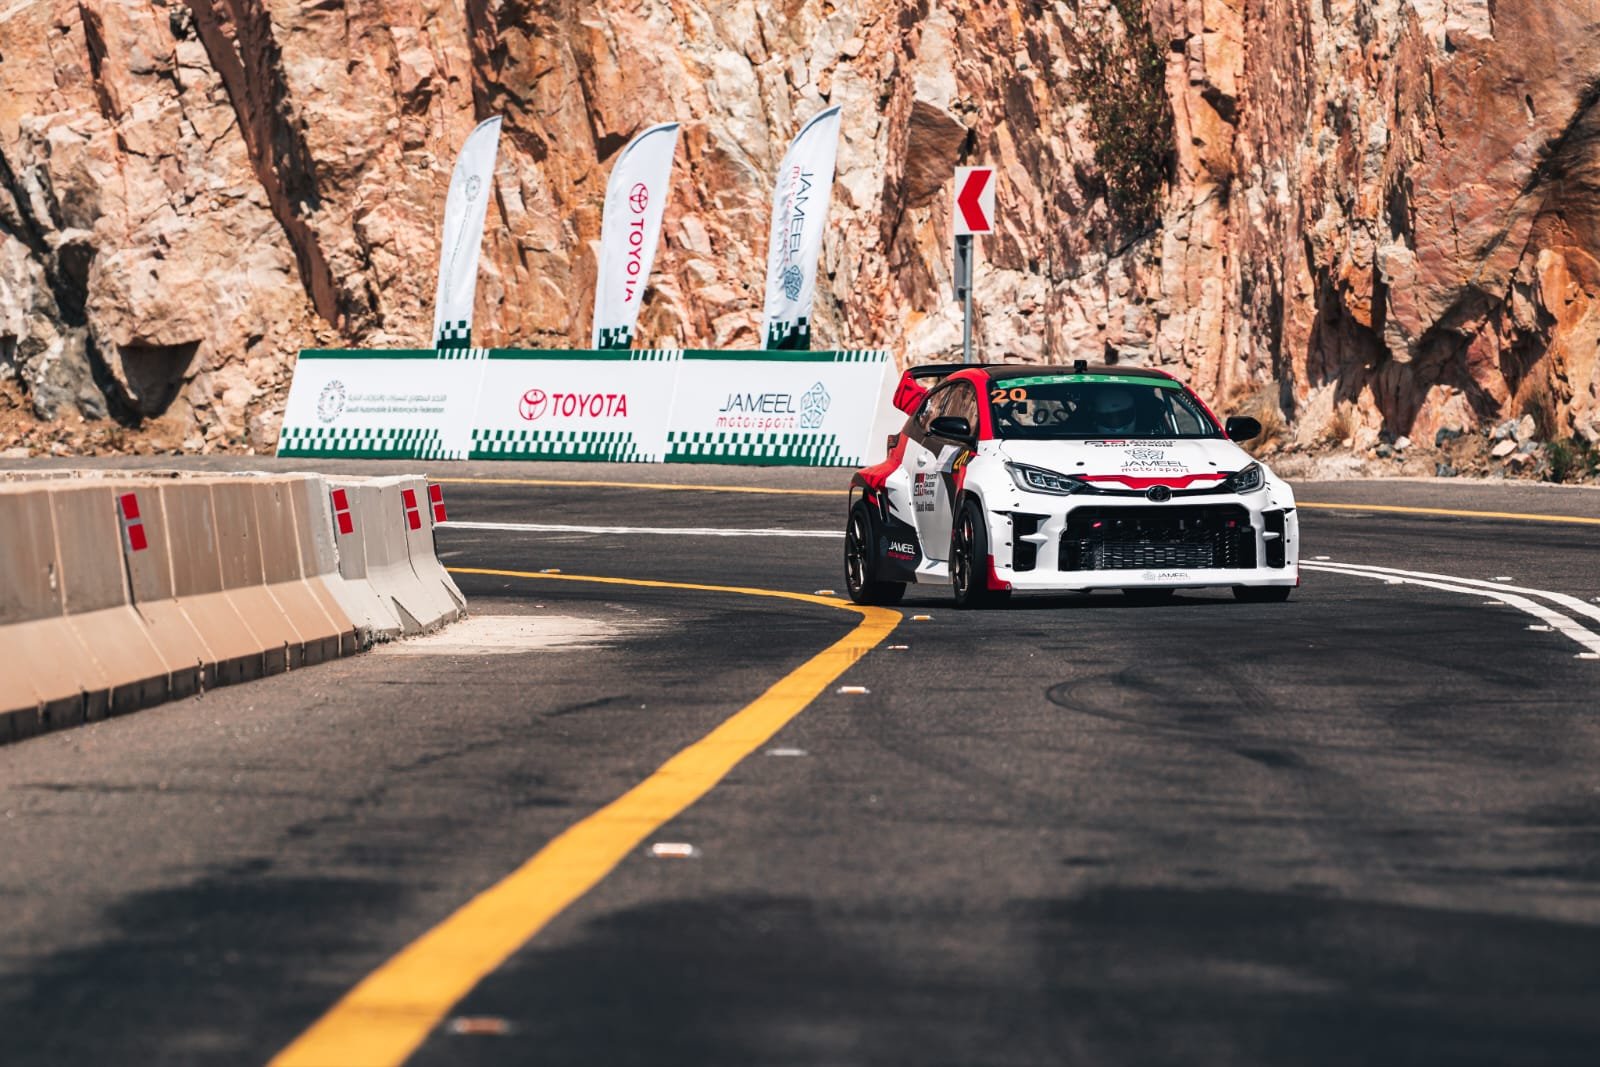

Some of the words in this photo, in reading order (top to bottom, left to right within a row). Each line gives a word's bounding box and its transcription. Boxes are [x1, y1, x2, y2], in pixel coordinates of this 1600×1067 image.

[789, 172, 814, 261] JAMEEL
[624, 218, 644, 302] TOYOTA
[552, 393, 627, 417] TOYOTA
[719, 393, 796, 413] JAMEEL
[991, 388, 1028, 404] 20
[716, 416, 796, 431] motorsport
[888, 541, 916, 554] JAMEEL
